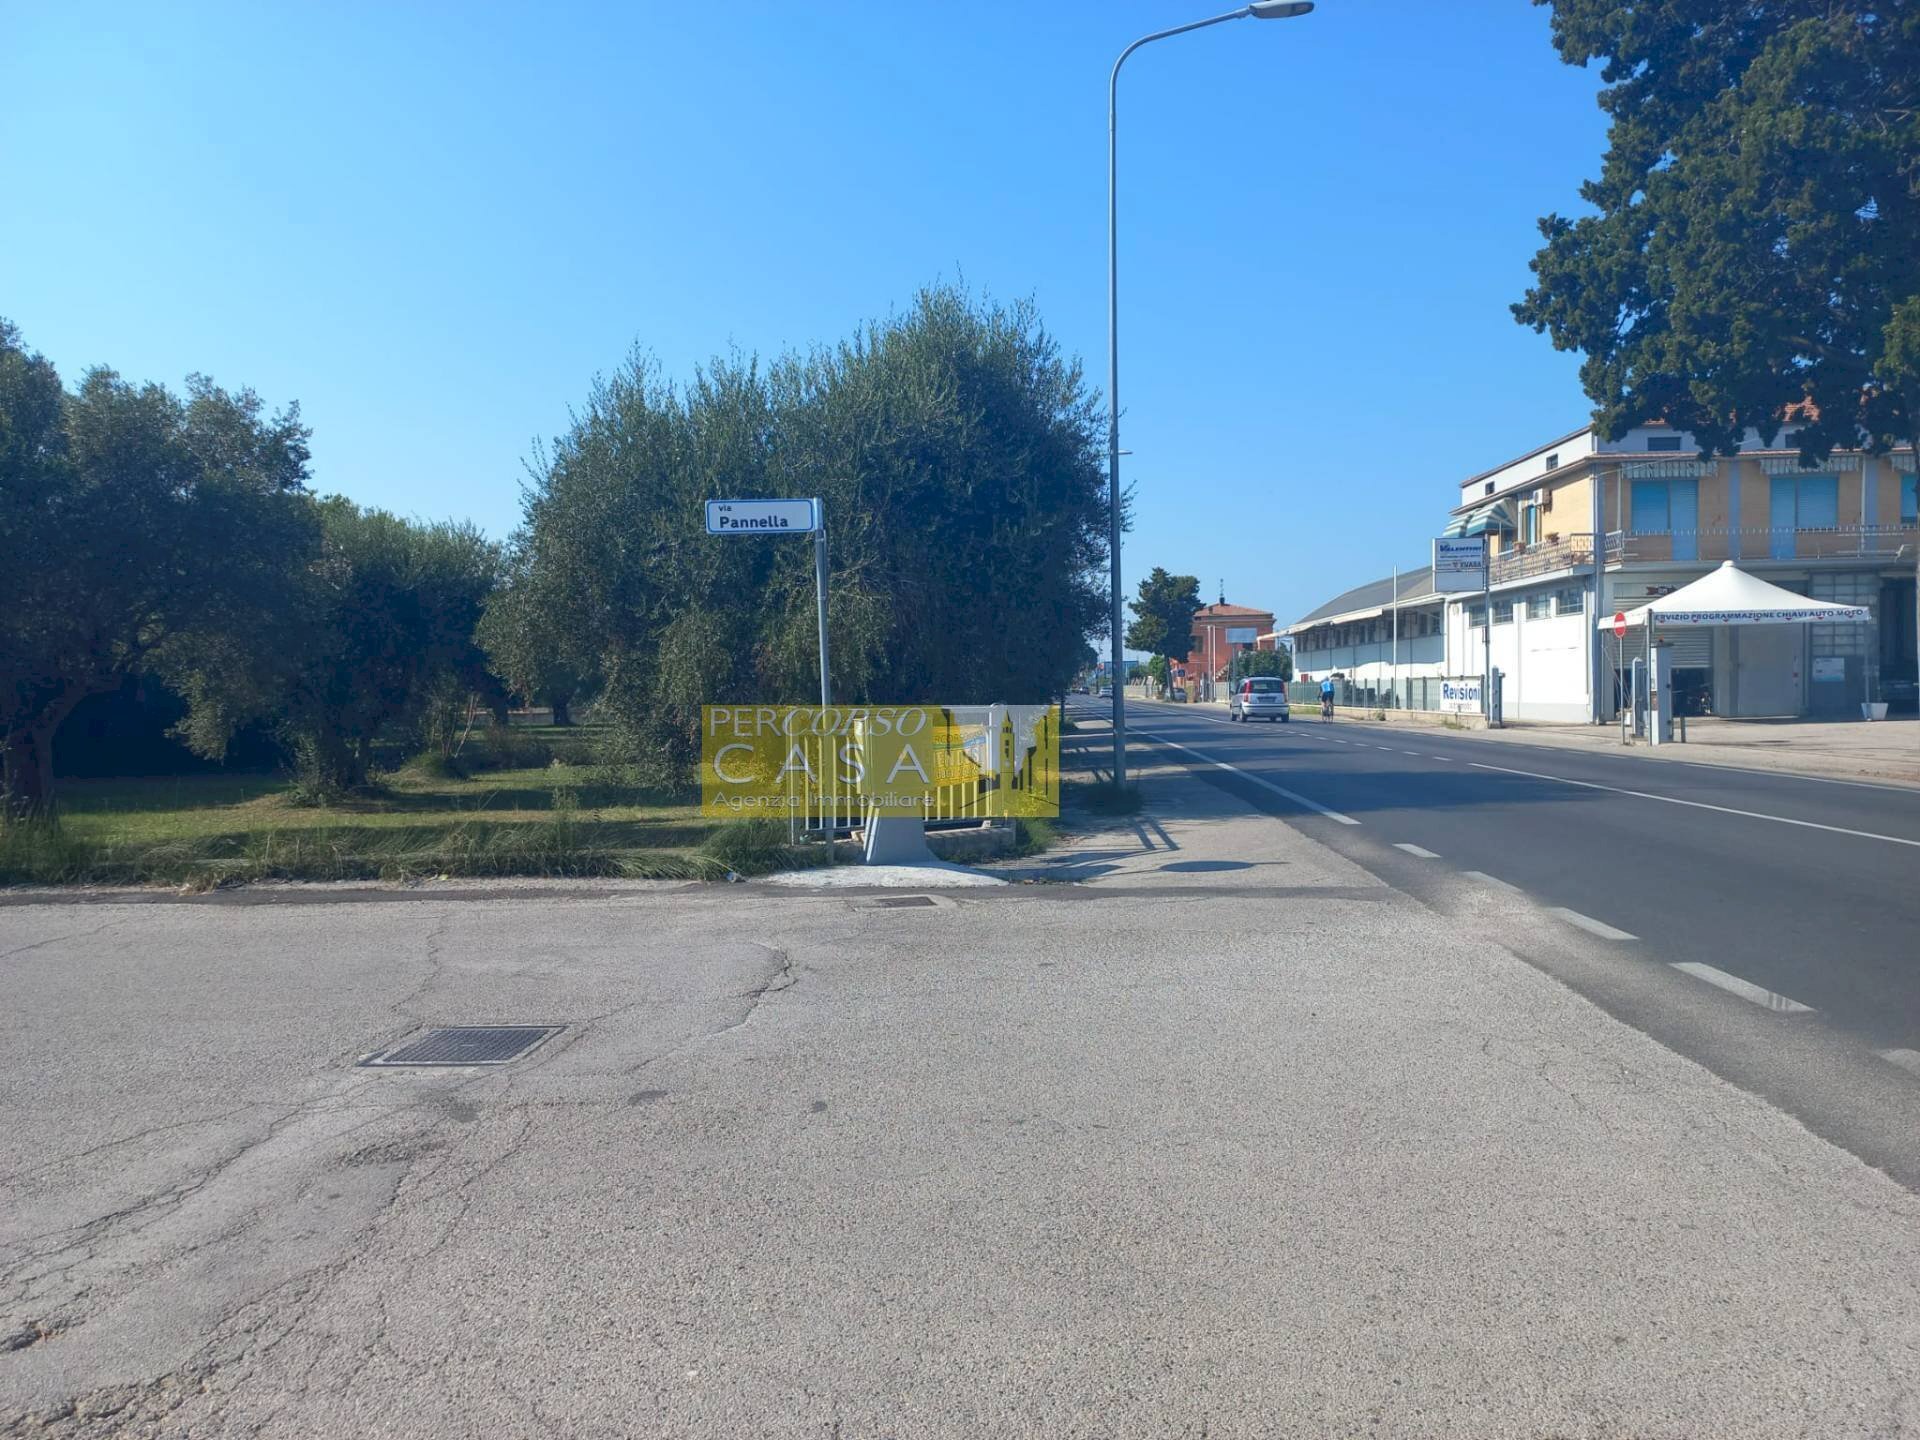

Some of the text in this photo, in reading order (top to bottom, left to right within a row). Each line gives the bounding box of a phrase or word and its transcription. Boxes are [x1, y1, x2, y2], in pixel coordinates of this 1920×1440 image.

[718, 504, 733, 512] via
[719, 515, 789, 529] Pannella
[1691, 612, 1775, 620] PROGRAMMAZIONE
[1776, 611, 1807, 619] CHIAVI
[1443, 683, 1481, 700] Revisioni
